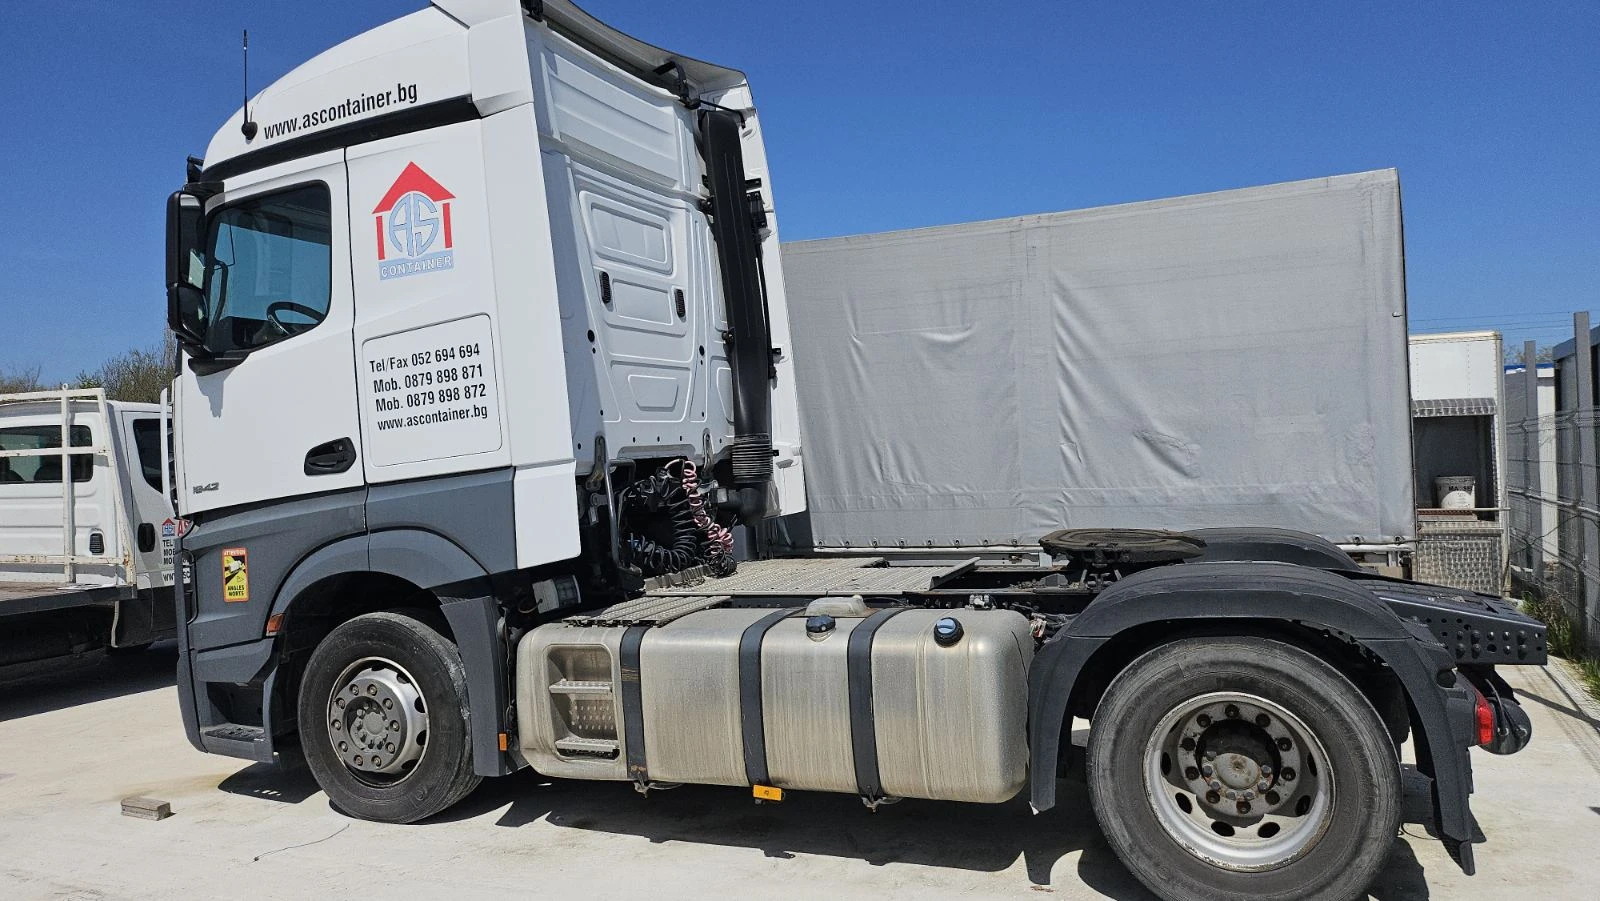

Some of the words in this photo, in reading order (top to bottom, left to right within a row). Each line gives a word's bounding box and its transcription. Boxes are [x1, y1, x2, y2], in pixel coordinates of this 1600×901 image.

[264, 83, 418, 140] www.ascontainer.bg
[381, 255, 452, 278] CONTAINER
[369, 356, 409, 373] Tel/Fax
[411, 351, 431, 366] 052
[435, 347, 455, 363] 694
[459, 343, 480, 359] 694
[373, 377, 401, 393] Mob.
[404, 371, 433, 389] 0879
[436, 367, 458, 384] 898
[462, 363, 483, 380] 871
[375, 396, 403, 412] Mob.
[406, 390, 435, 408] 0879
[438, 387, 460, 403] 898
[464, 383, 487, 399] 872
[377, 404, 488, 431] www.ascontainer.bg
[163, 556, 175, 566] MO
